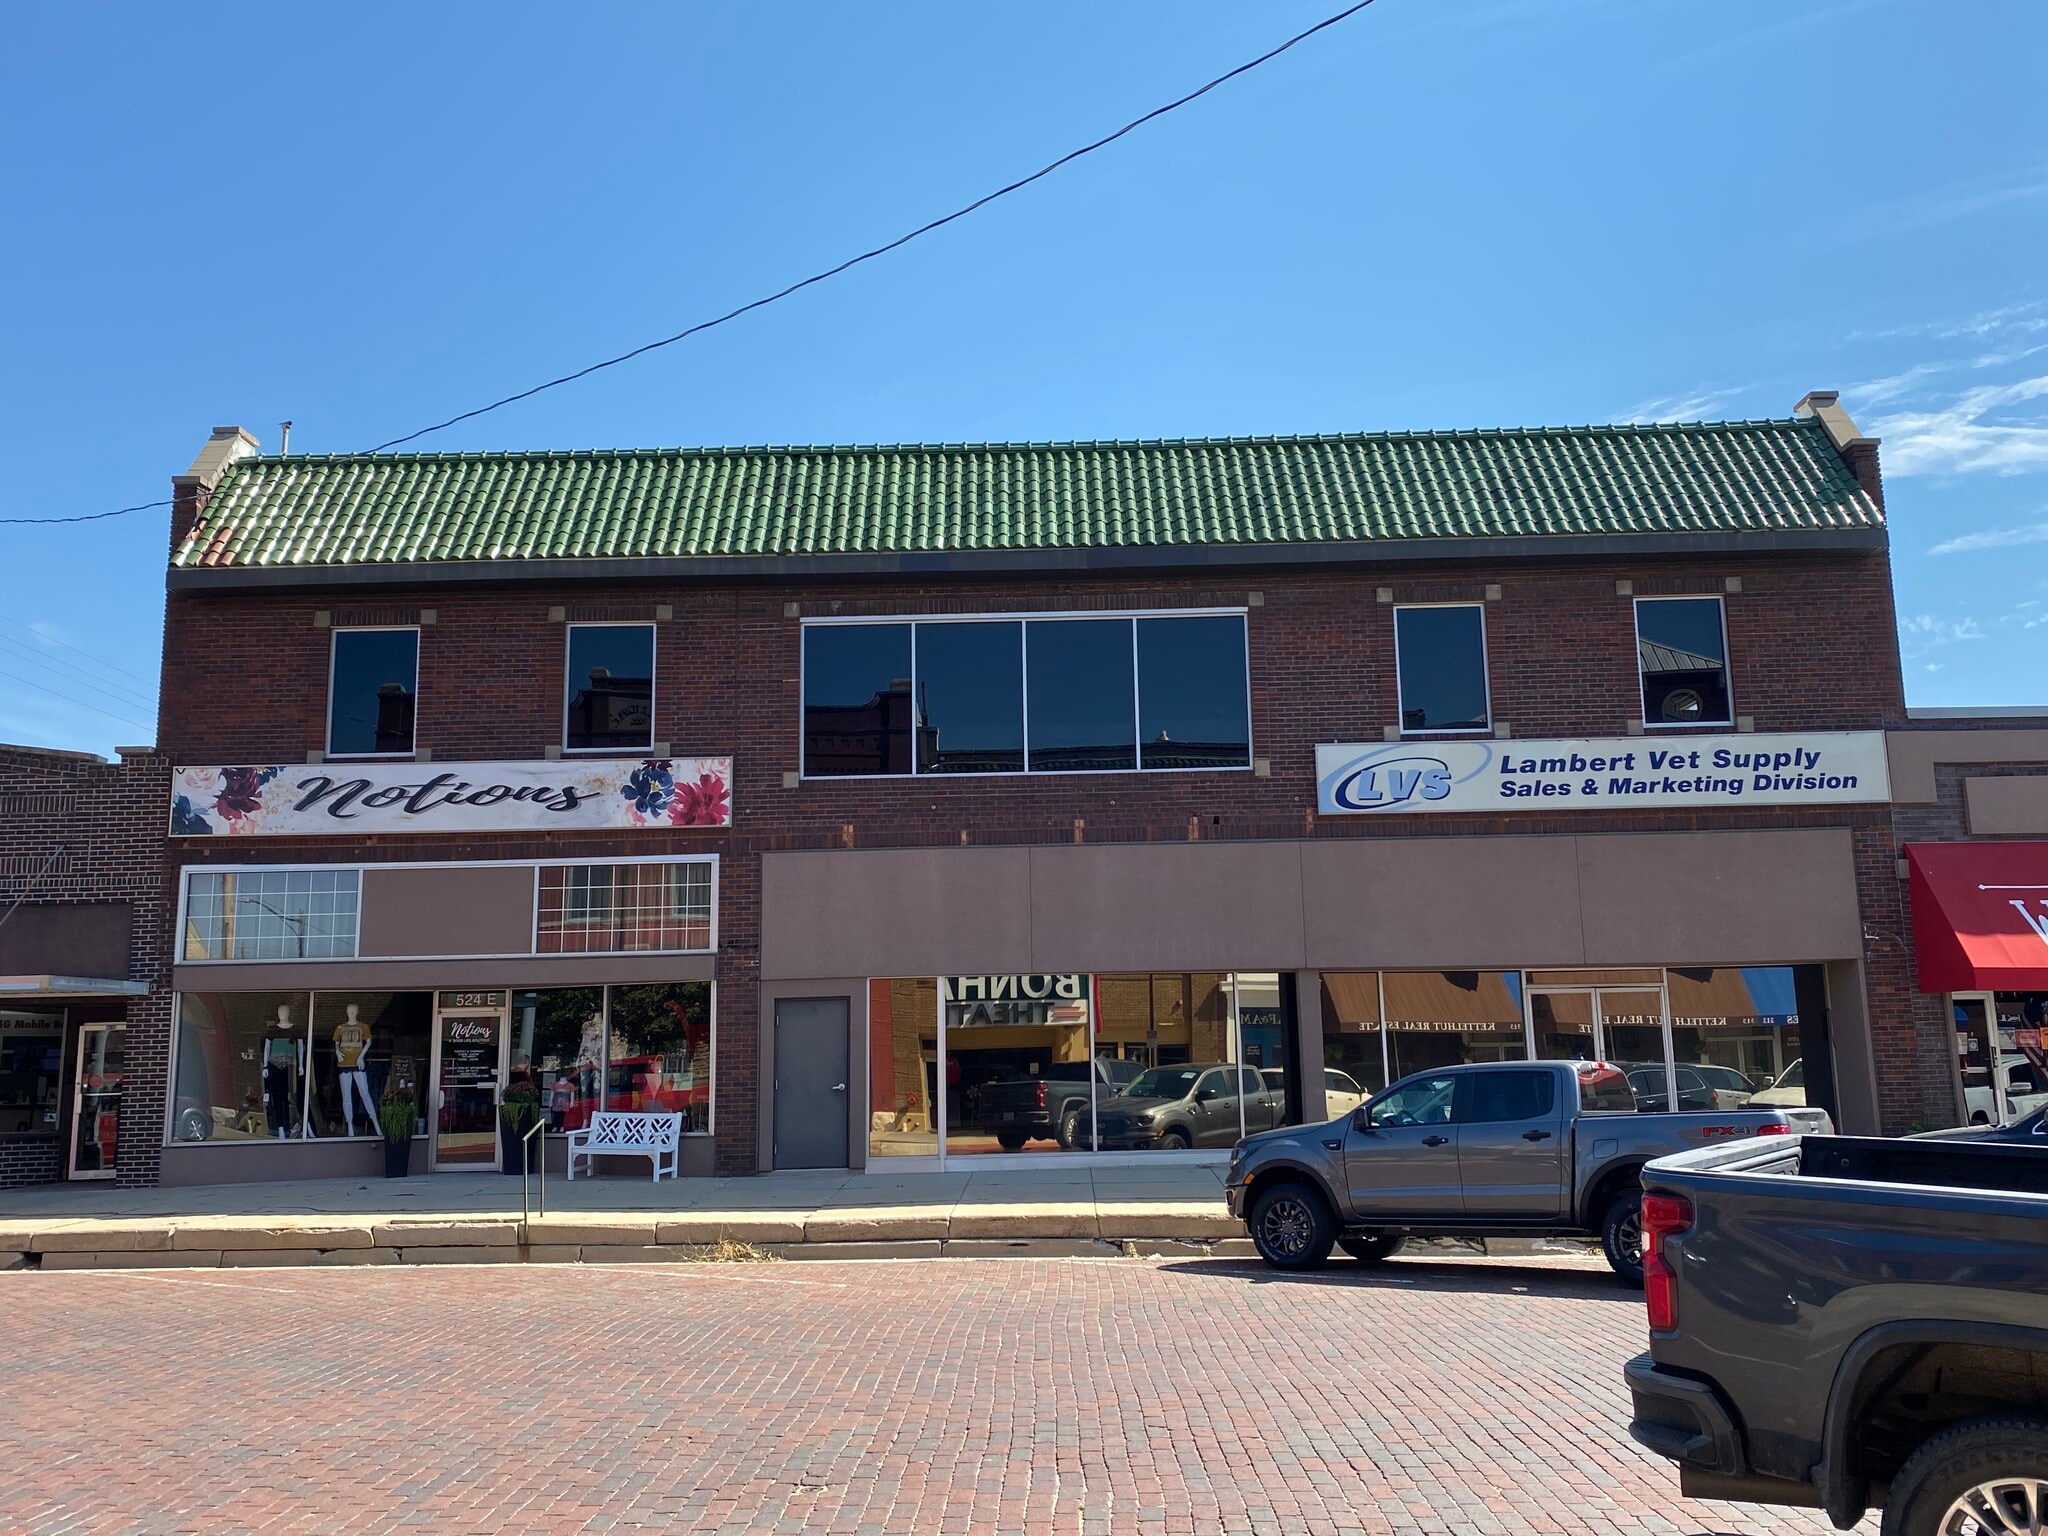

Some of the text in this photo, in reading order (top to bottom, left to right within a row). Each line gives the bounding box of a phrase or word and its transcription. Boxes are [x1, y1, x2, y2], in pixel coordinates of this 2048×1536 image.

[1500, 747, 1822, 774] Lambert Vet Supply
[1356, 768, 1452, 801] LVS
[1500, 772, 1858, 798] Sales & Marketing Division
[296, 773, 600, 819] Notions
[455, 993, 497, 1006] 524 E
[14, 1019, 50, 1029] Mobile
[450, 1022, 492, 1038] Notions
[1702, 1125, 1751, 1138] FX4
